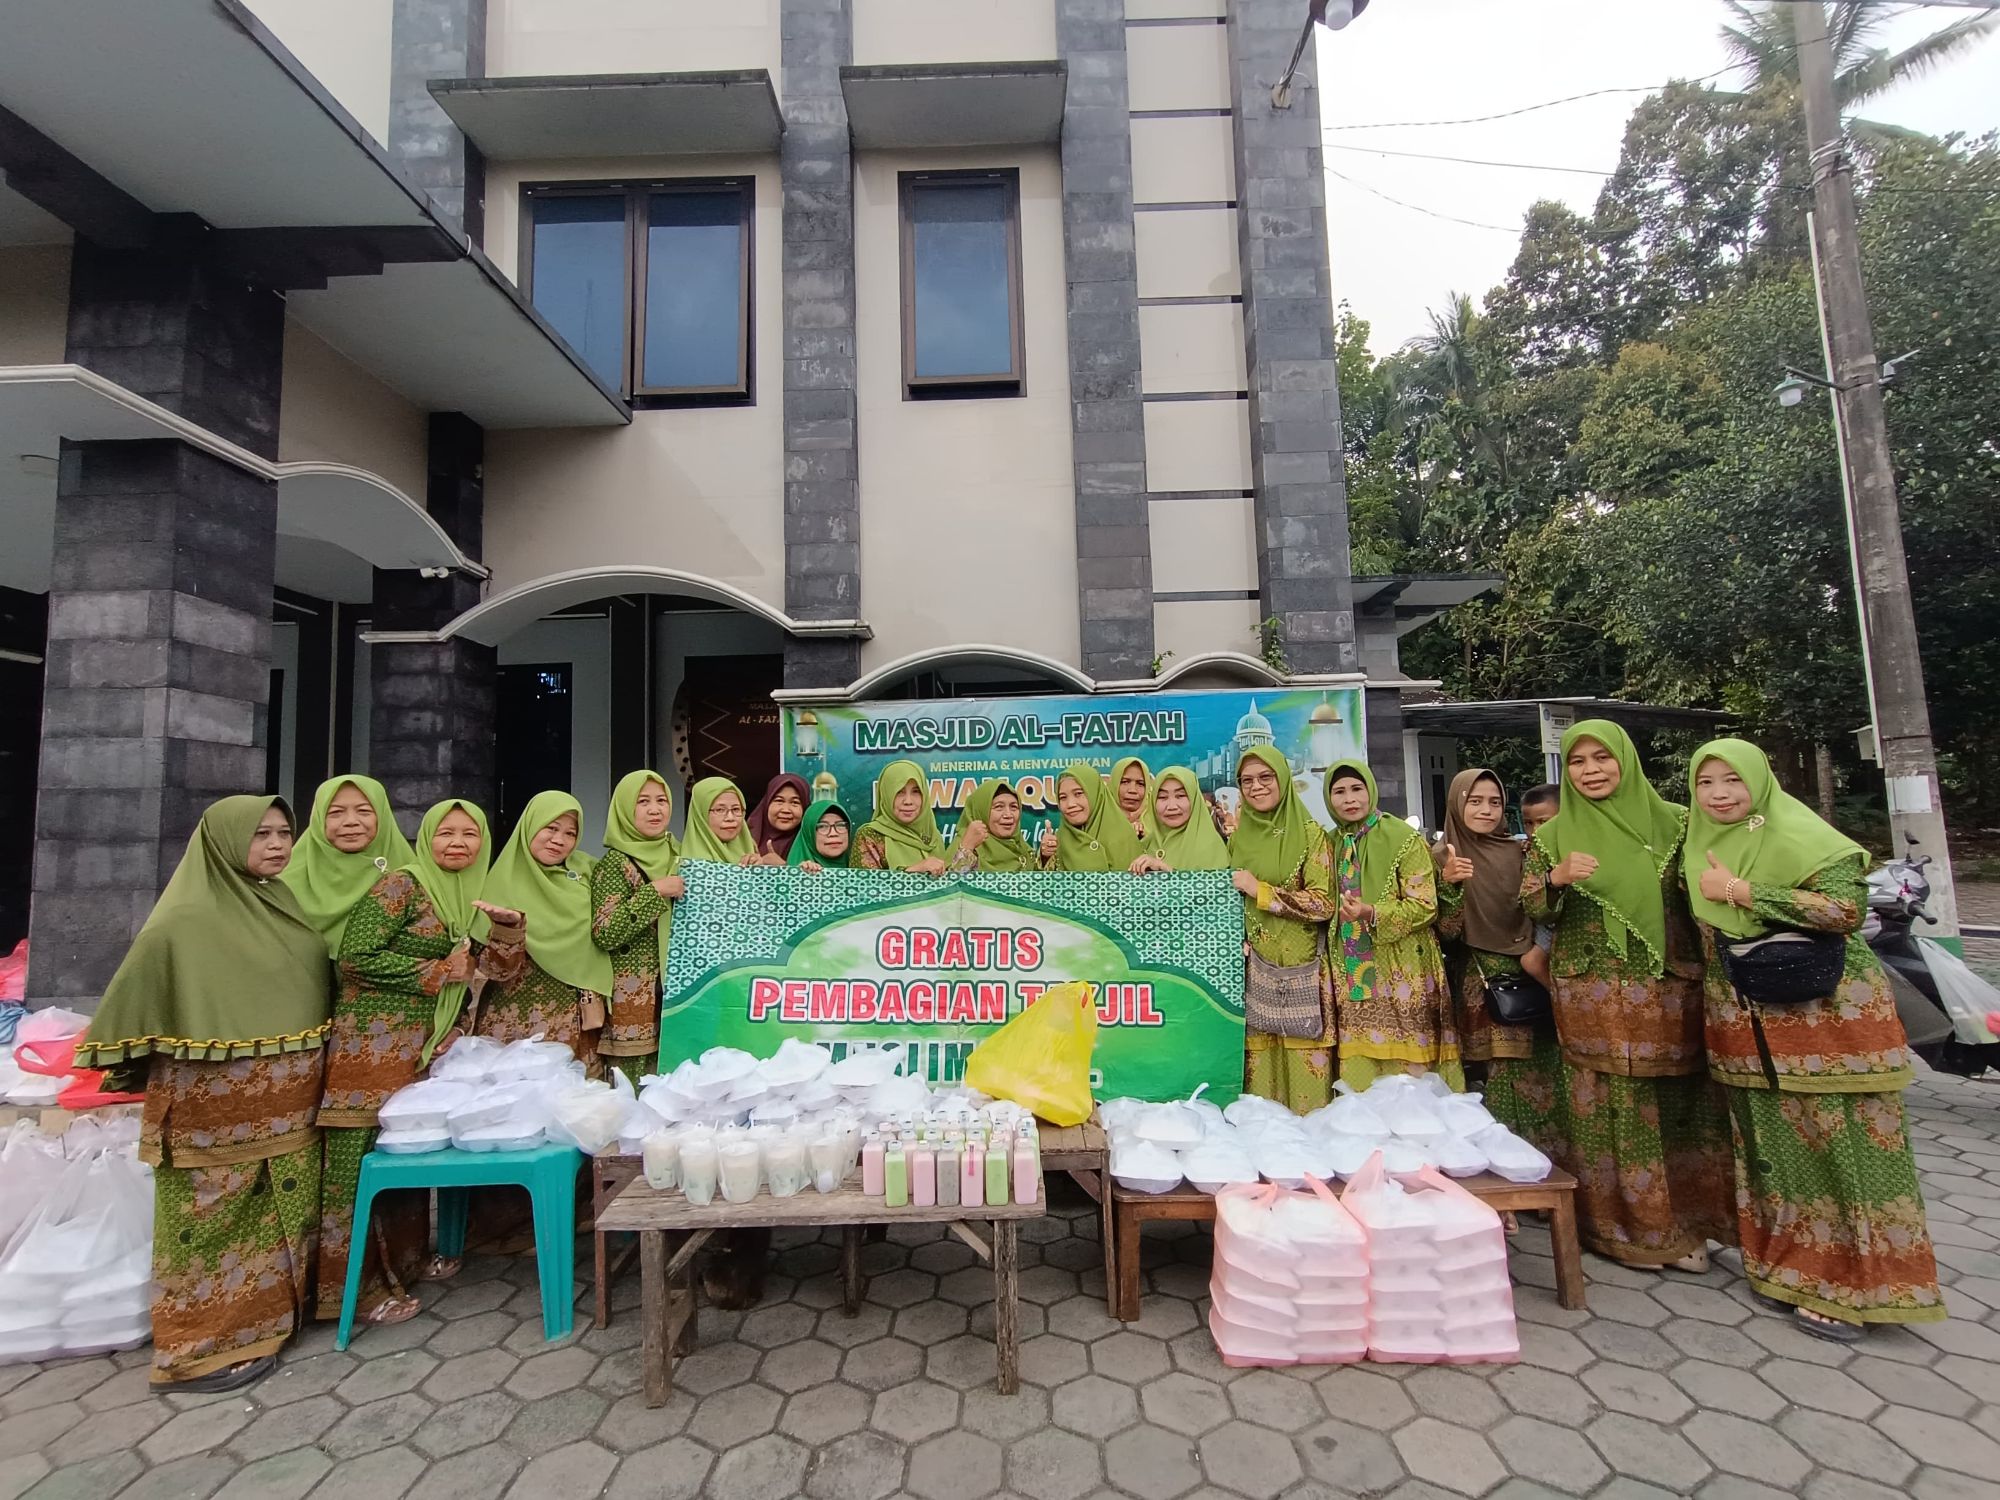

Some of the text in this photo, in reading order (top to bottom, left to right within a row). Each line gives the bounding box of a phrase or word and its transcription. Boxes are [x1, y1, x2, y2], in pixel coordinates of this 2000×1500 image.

[758, 715, 780, 724] FAT
[855, 710, 1185, 750] MASJID AL-FATAH
[930, 757, 1111, 772] MENERIMA & MENYALURKAN
[879, 929, 1041, 969] GRATIS
[750, 979, 1163, 1025] PEMBAGIAN TJIL
